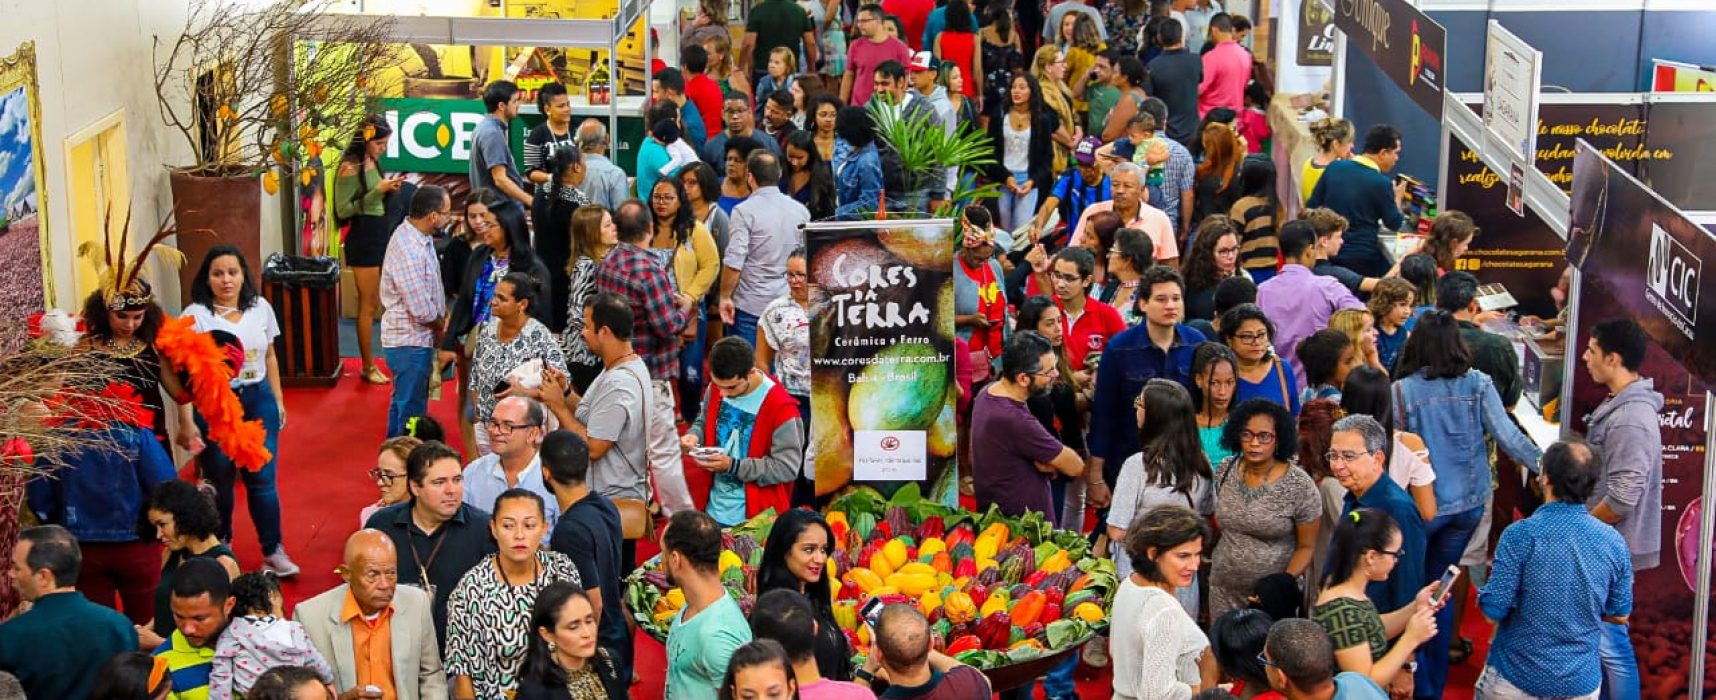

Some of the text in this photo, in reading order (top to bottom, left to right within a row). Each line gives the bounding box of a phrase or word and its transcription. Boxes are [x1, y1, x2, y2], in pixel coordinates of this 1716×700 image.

[832, 253, 917, 289] CORES
[1671, 256, 1696, 308] CIC
[832, 293, 930, 329] TERRA
[900, 334, 930, 345] Ferro
[813, 352, 951, 366] www.coresdaterra.com.br
[887, 371, 917, 382] Brasil
